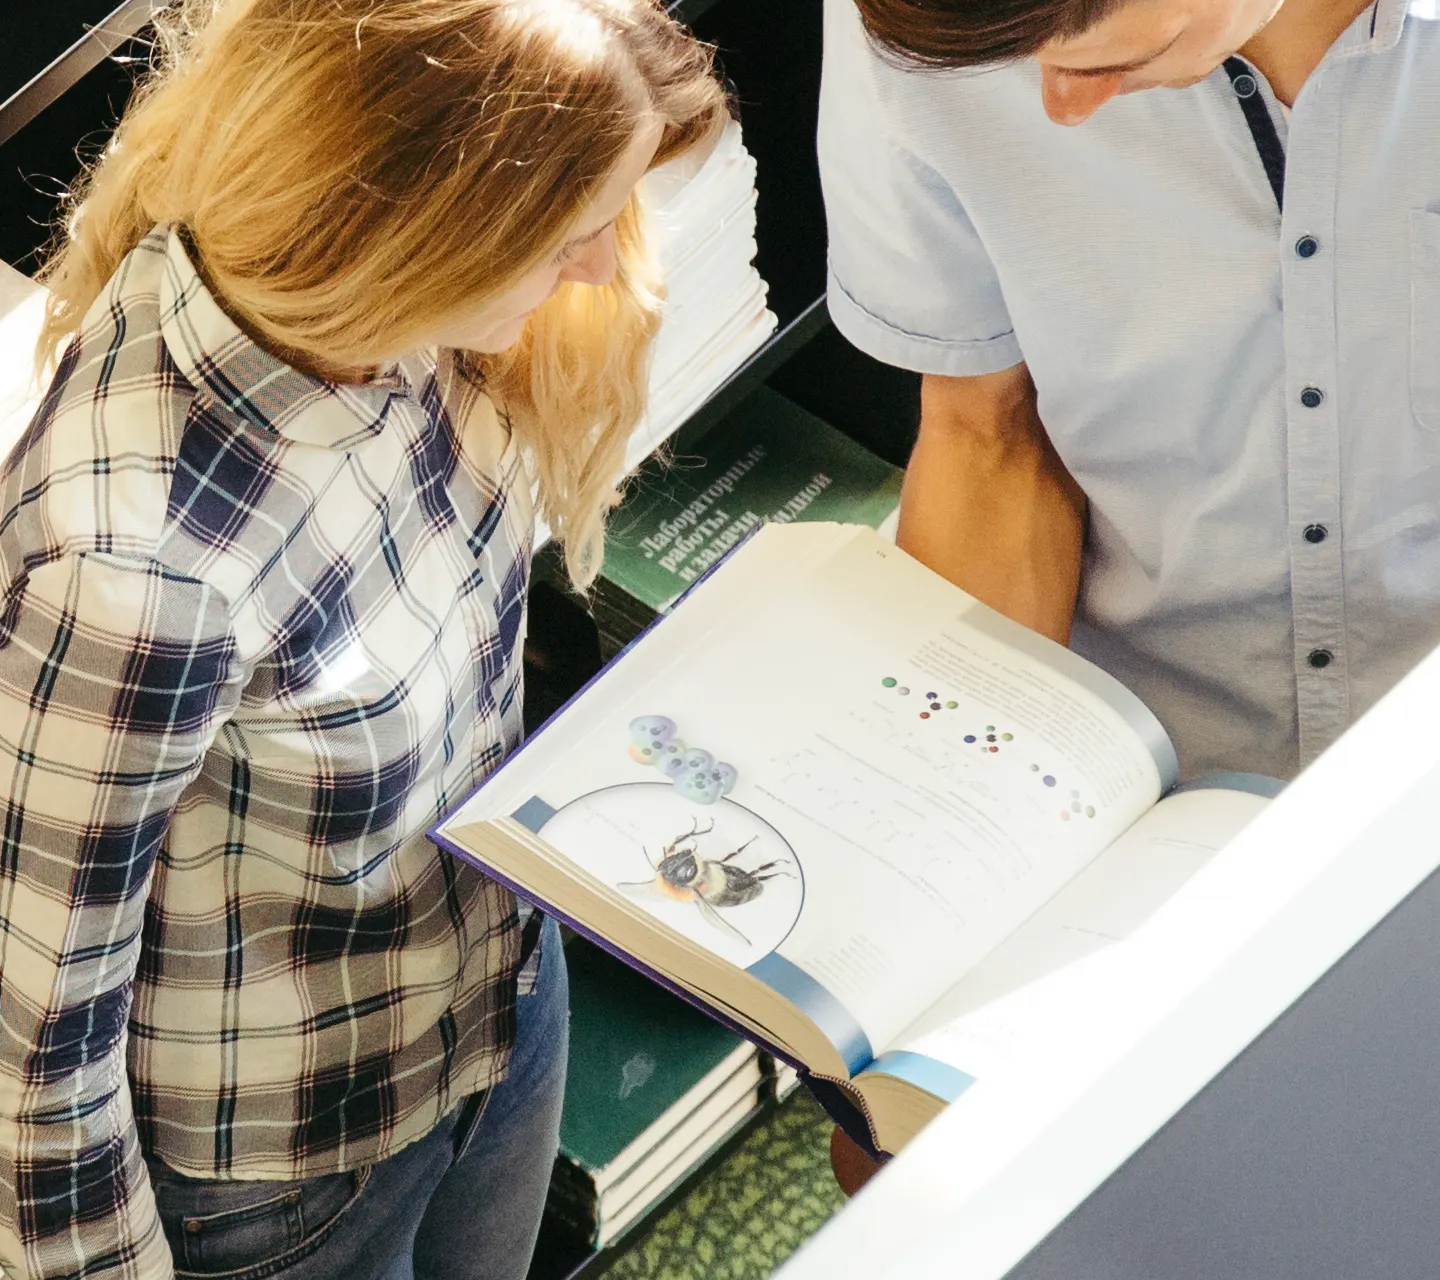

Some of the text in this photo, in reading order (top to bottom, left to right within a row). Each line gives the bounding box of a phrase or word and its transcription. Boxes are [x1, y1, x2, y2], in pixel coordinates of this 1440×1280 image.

[638, 444, 768, 560] Лабораторные
[658, 509, 731, 574] работы
[678, 510, 760, 582] и задачи
